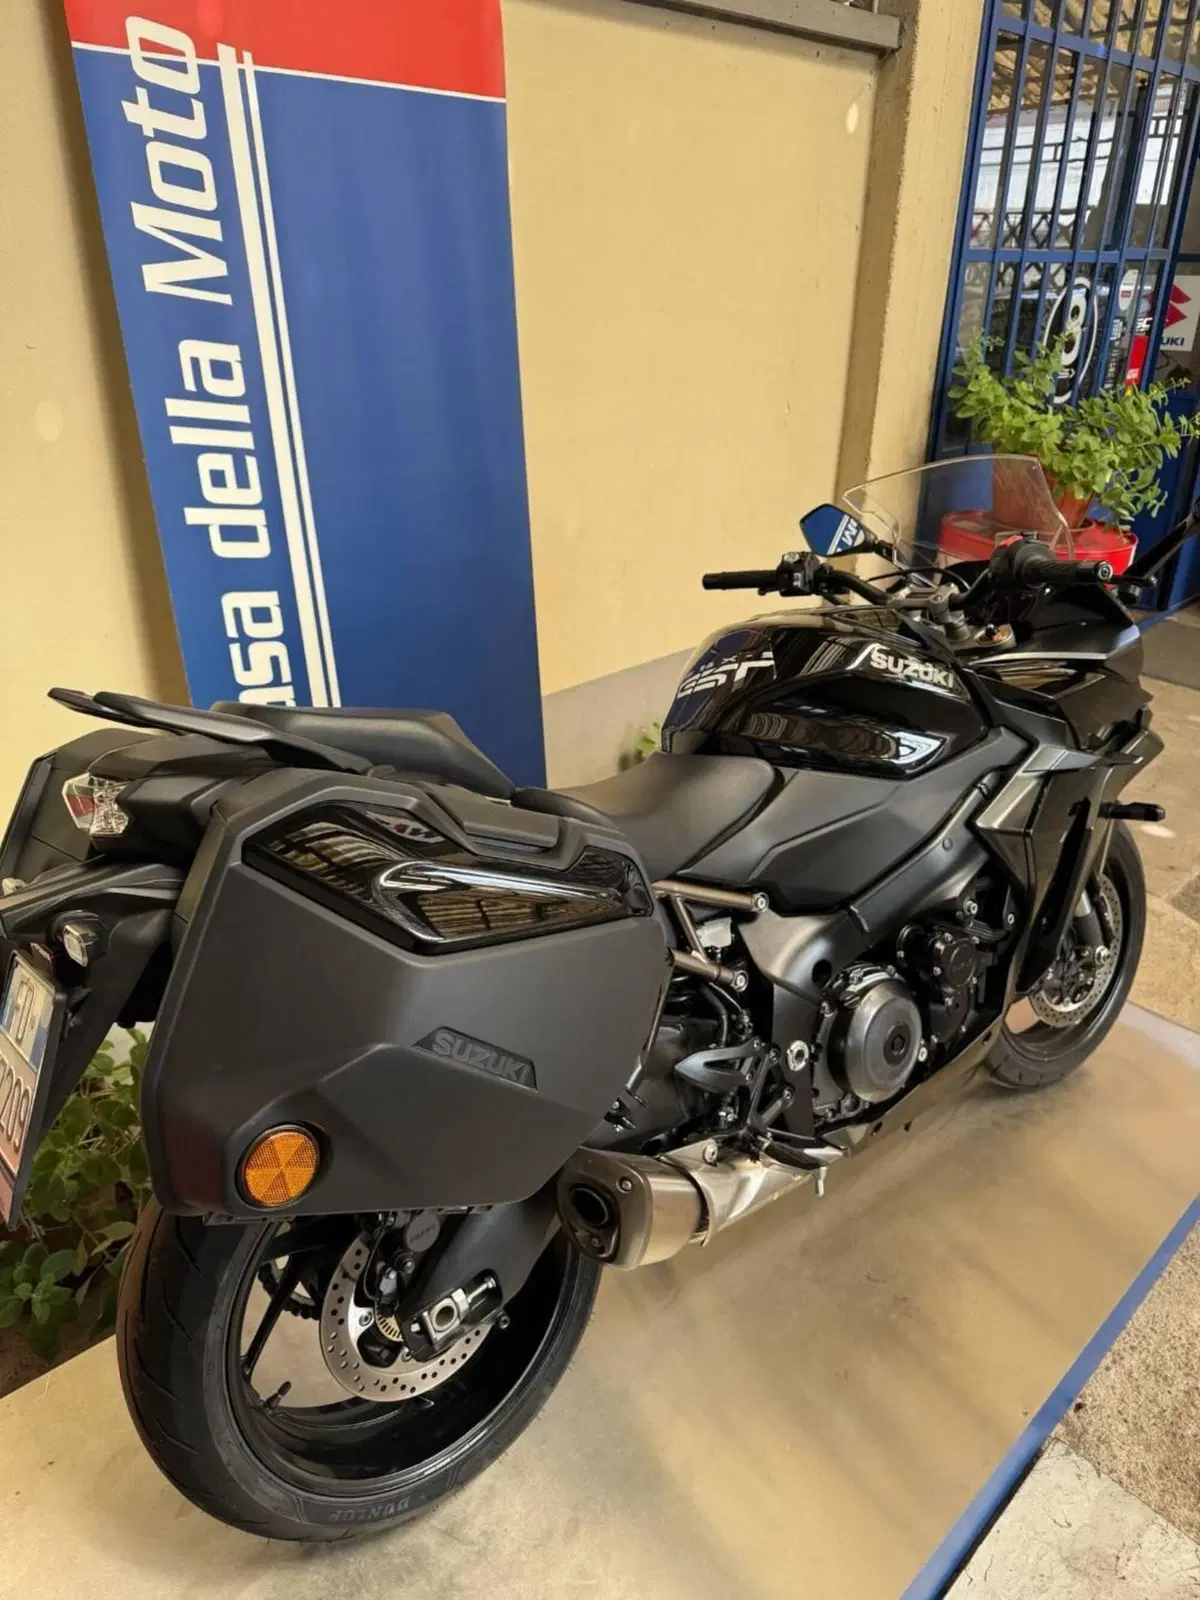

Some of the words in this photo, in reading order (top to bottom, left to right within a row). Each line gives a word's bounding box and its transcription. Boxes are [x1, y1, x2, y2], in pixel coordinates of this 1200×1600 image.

[121, 16, 233, 305] Moto
[164, 339, 271, 559] della
[221, 590, 297, 706] sa
[870, 645, 955, 688] SUZUKI
[432, 1031, 531, 1084] SUZUKI
